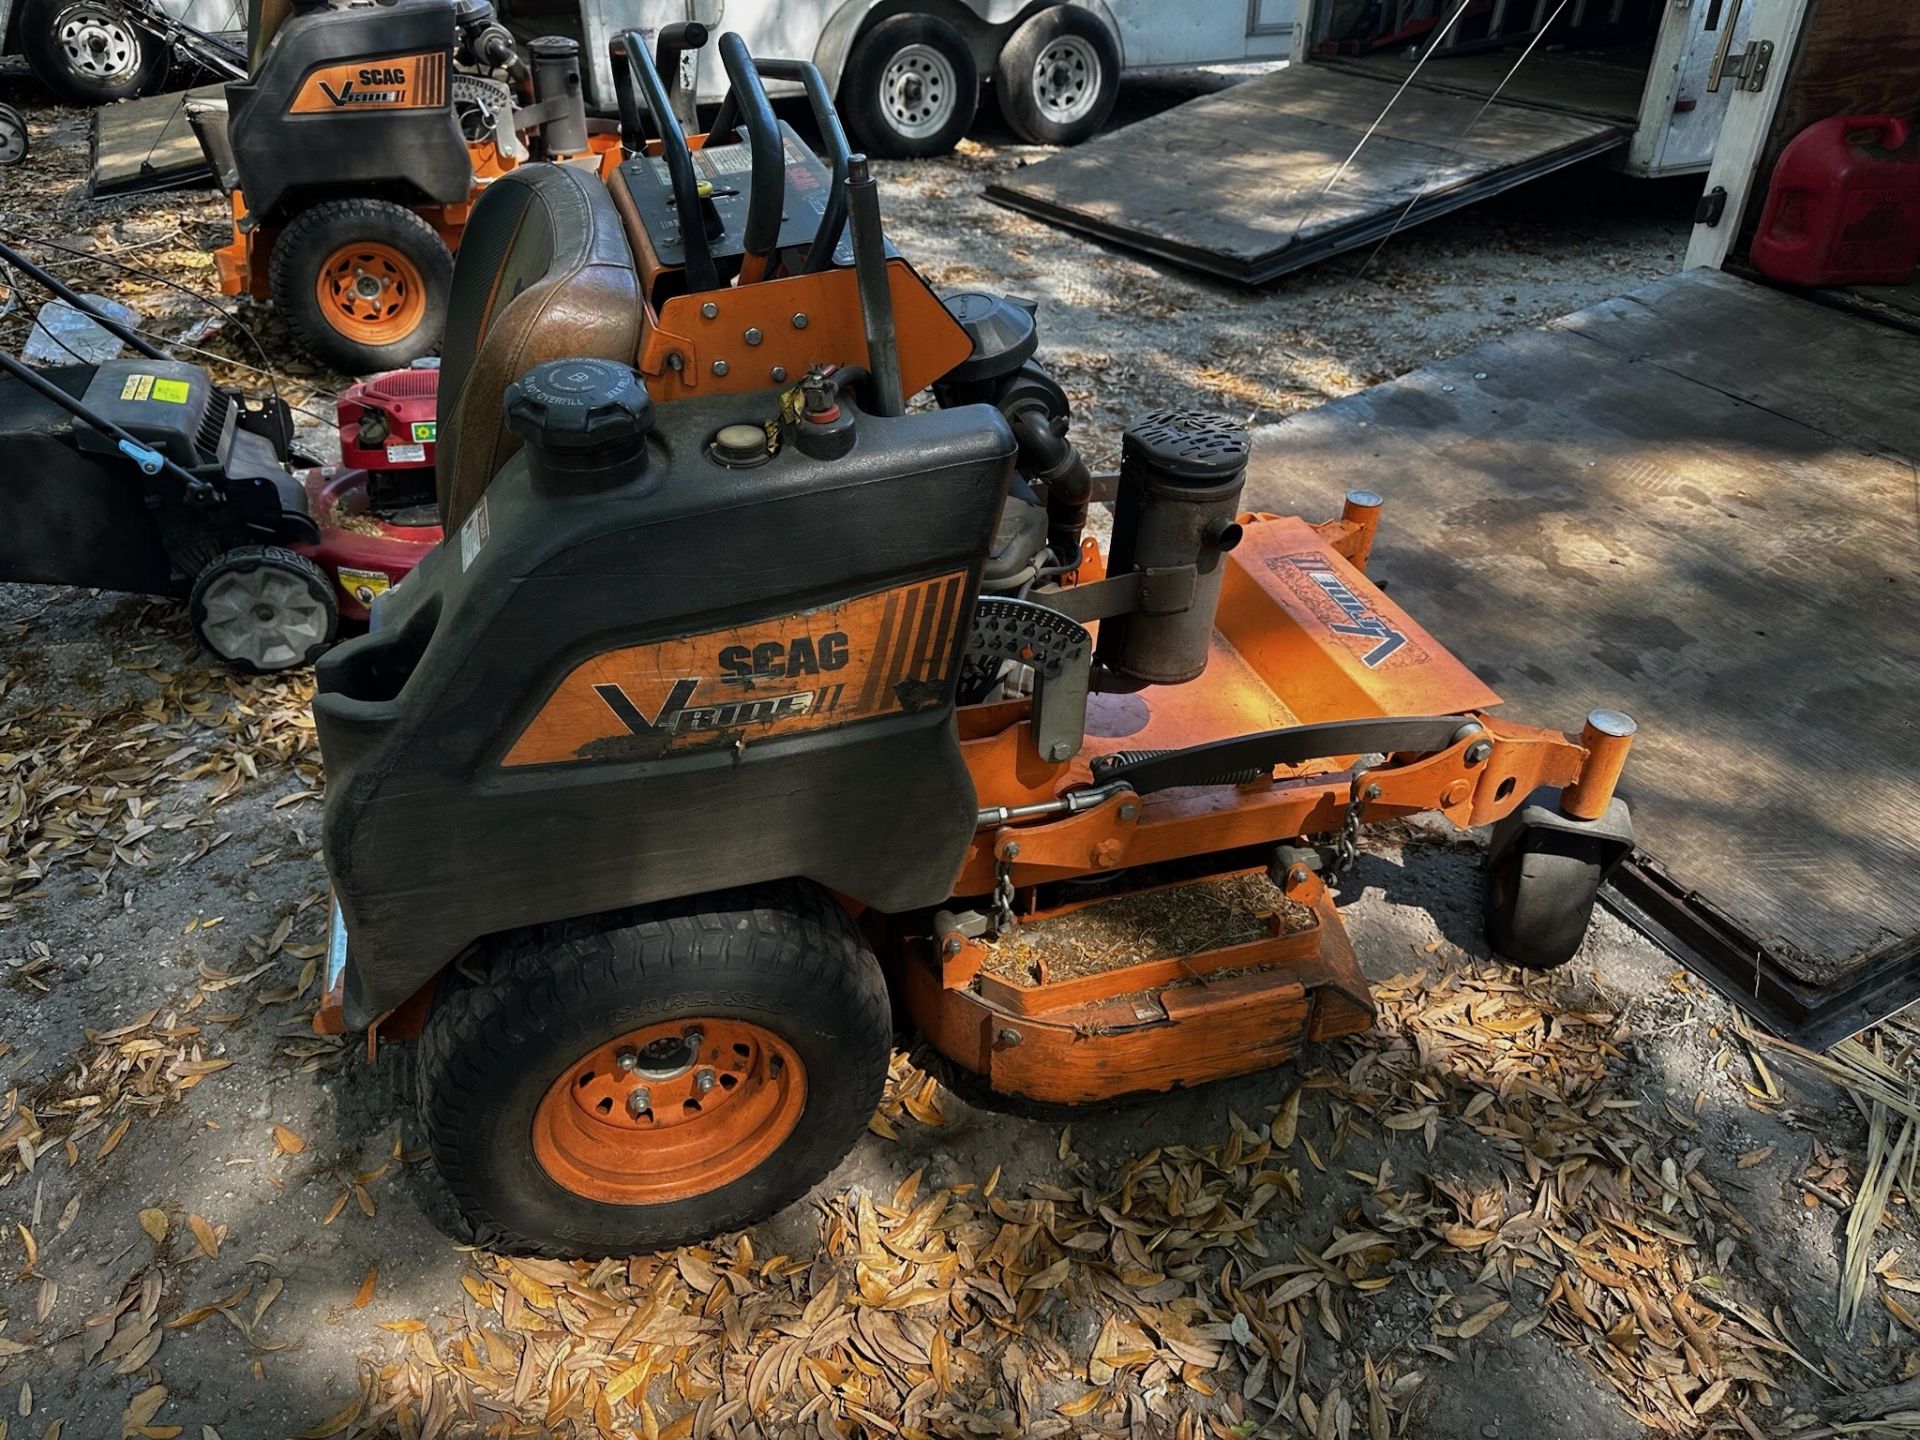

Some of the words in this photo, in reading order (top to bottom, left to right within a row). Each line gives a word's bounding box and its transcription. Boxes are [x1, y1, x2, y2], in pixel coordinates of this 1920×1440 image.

[359, 68, 405, 86] SCAG
[537, 392, 584, 406] OVERFILL
[718, 631, 849, 684] SCAG
